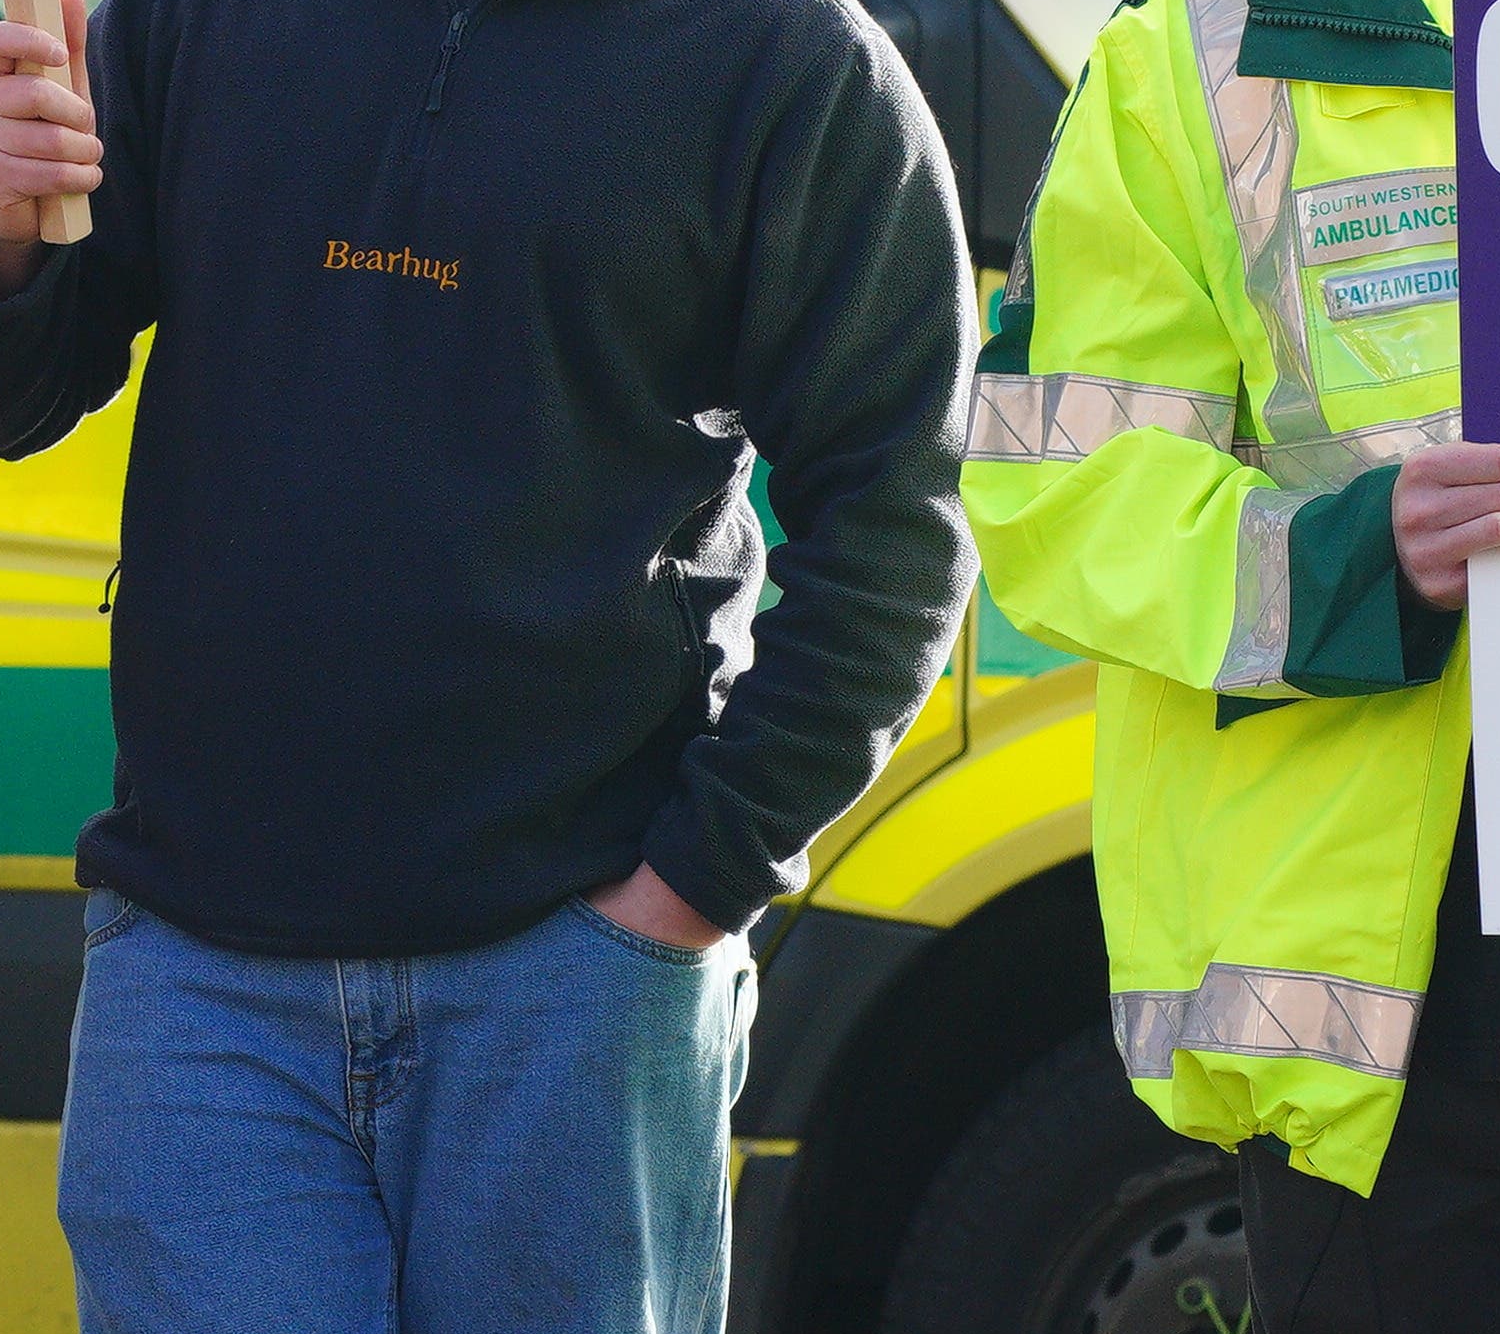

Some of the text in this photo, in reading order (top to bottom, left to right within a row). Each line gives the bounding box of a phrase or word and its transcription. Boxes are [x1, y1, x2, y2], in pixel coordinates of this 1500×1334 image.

[1308, 181, 1456, 218] SOUTH WESTERN
[1312, 204, 1458, 249] AMBULANCE
[322, 240, 460, 291] Bearhug
